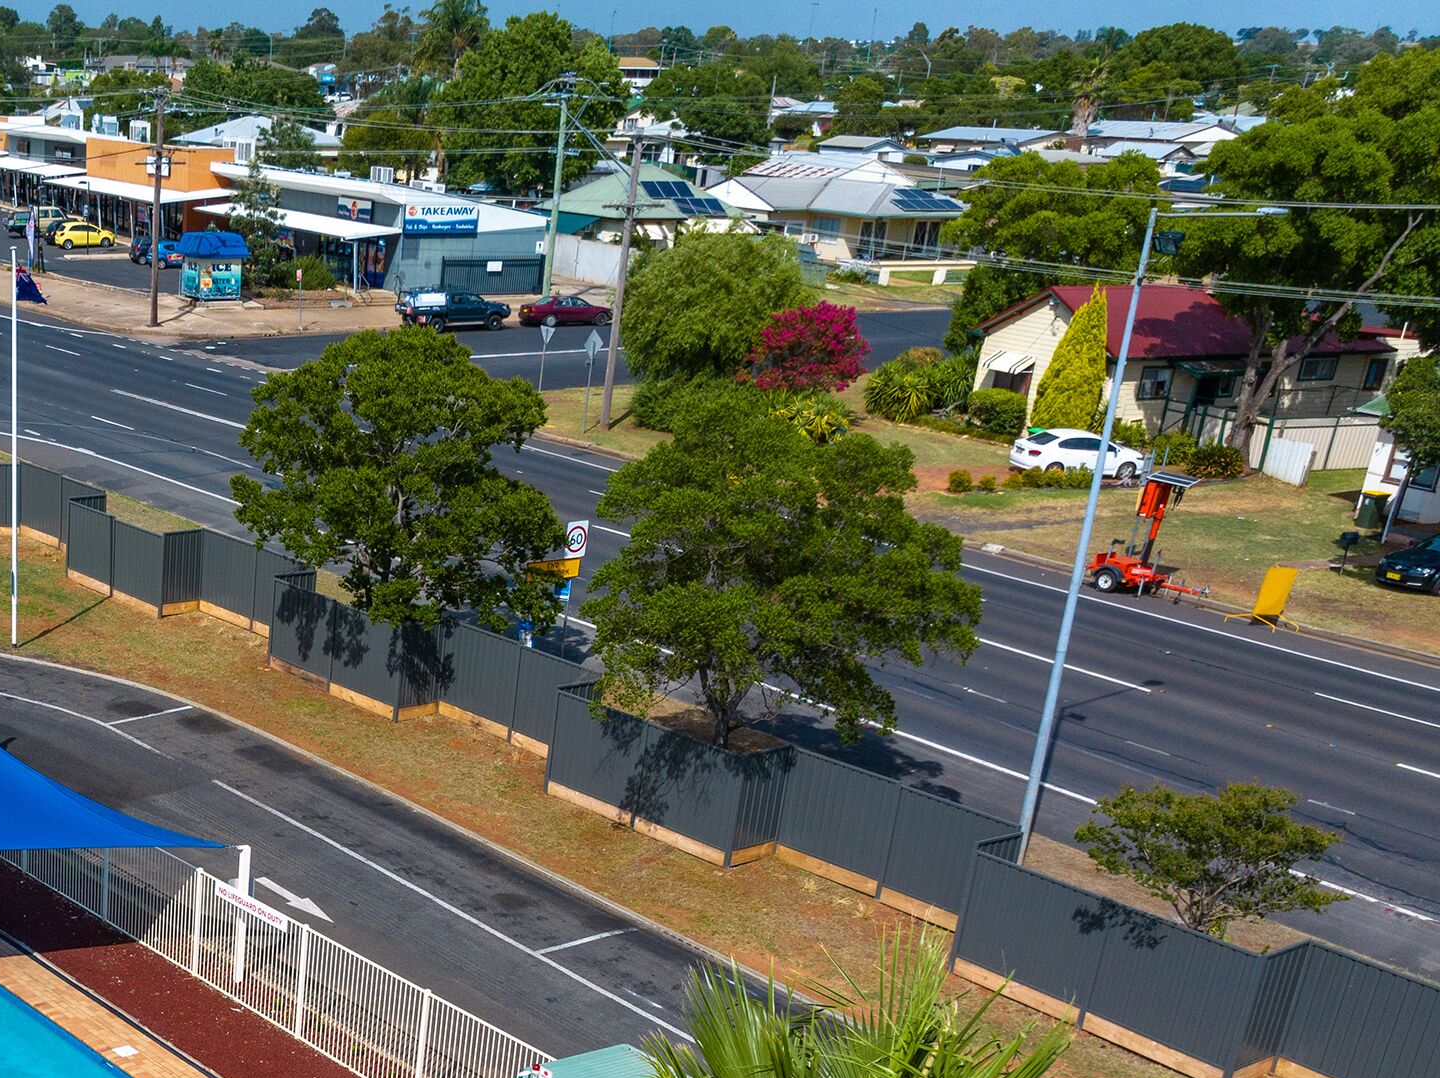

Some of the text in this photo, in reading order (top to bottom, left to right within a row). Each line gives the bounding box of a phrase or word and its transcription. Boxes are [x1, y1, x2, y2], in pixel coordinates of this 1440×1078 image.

[420, 206, 476, 216] TAKEAWAY
[211, 262, 232, 272] ICE
[570, 533, 583, 546] 60
[546, 562, 560, 570] END
[218, 887, 283, 925] NO LIFEGUARD ON DUTY
